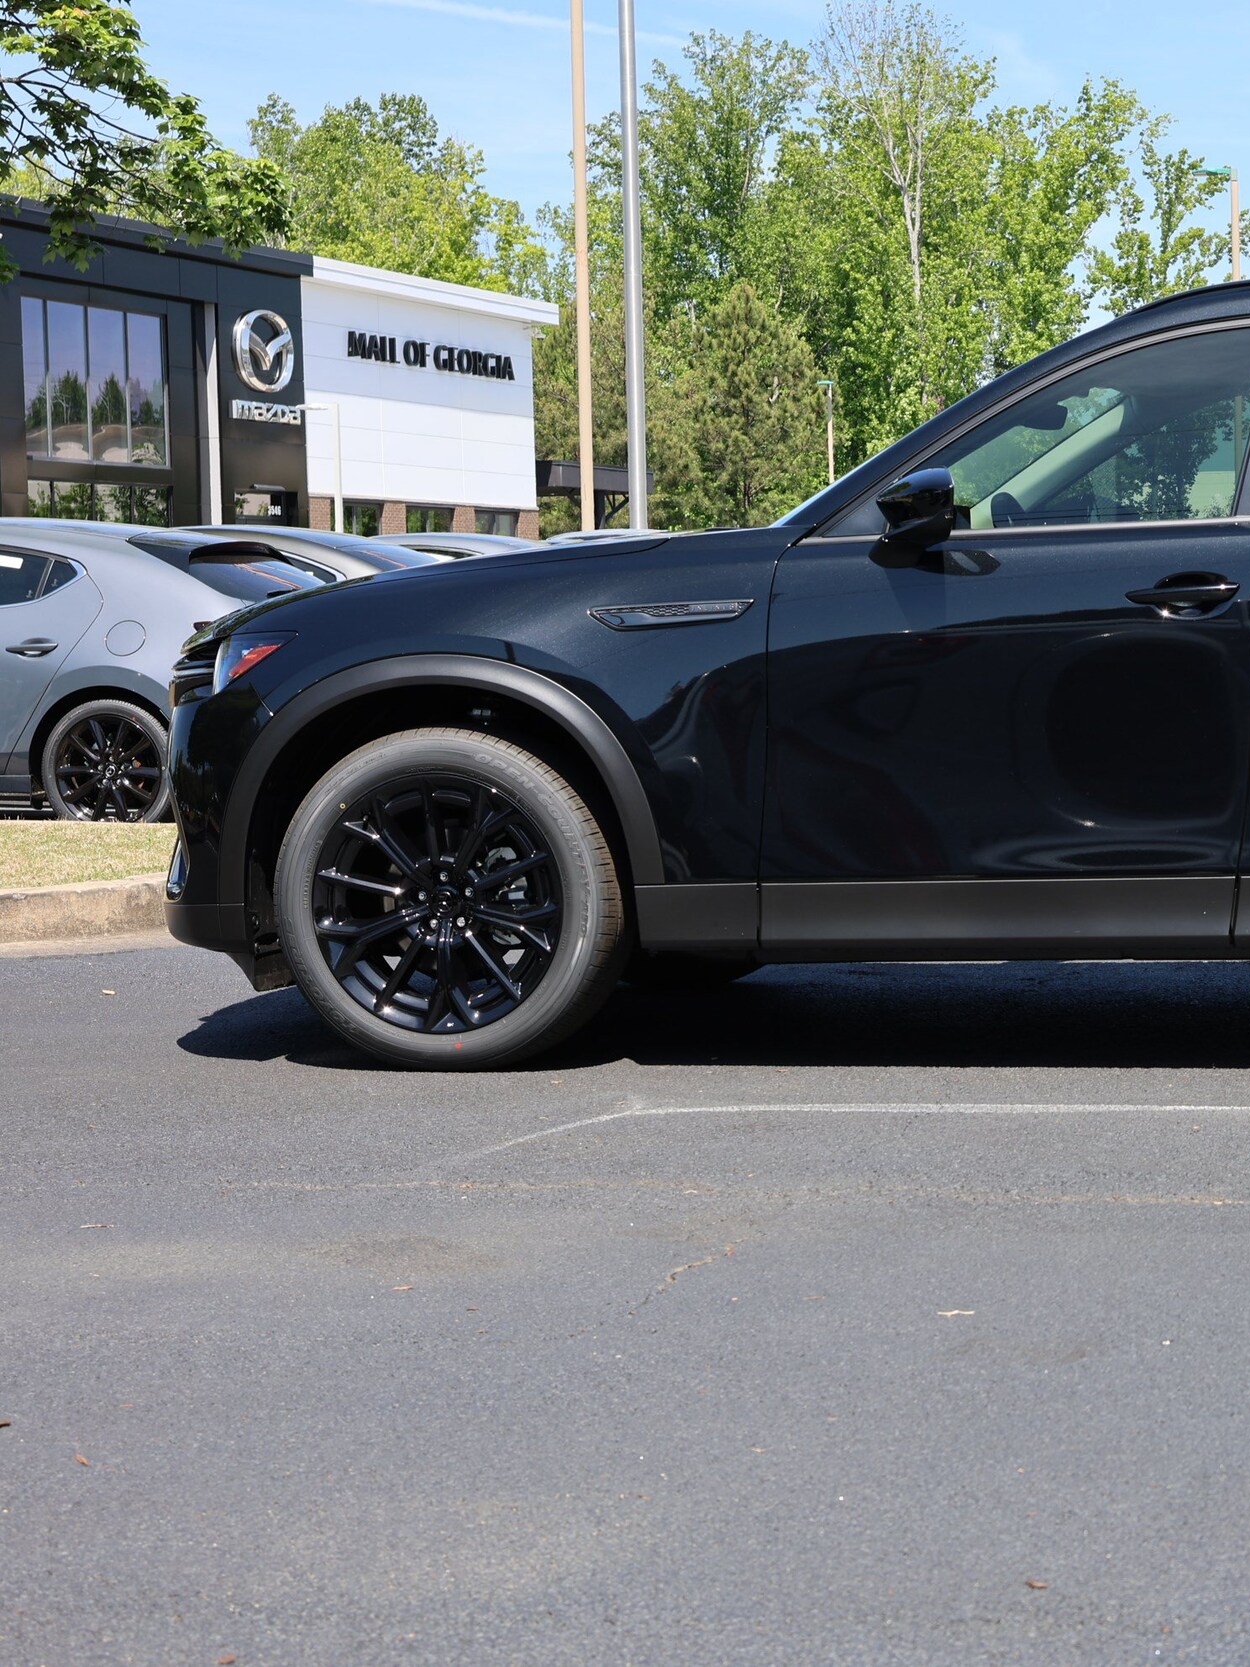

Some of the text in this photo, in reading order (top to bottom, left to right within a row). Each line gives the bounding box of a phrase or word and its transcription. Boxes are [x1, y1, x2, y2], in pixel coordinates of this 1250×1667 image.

[348, 331, 515, 381] MALL OF GEORGIA
[267, 505, 282, 516] 3546
